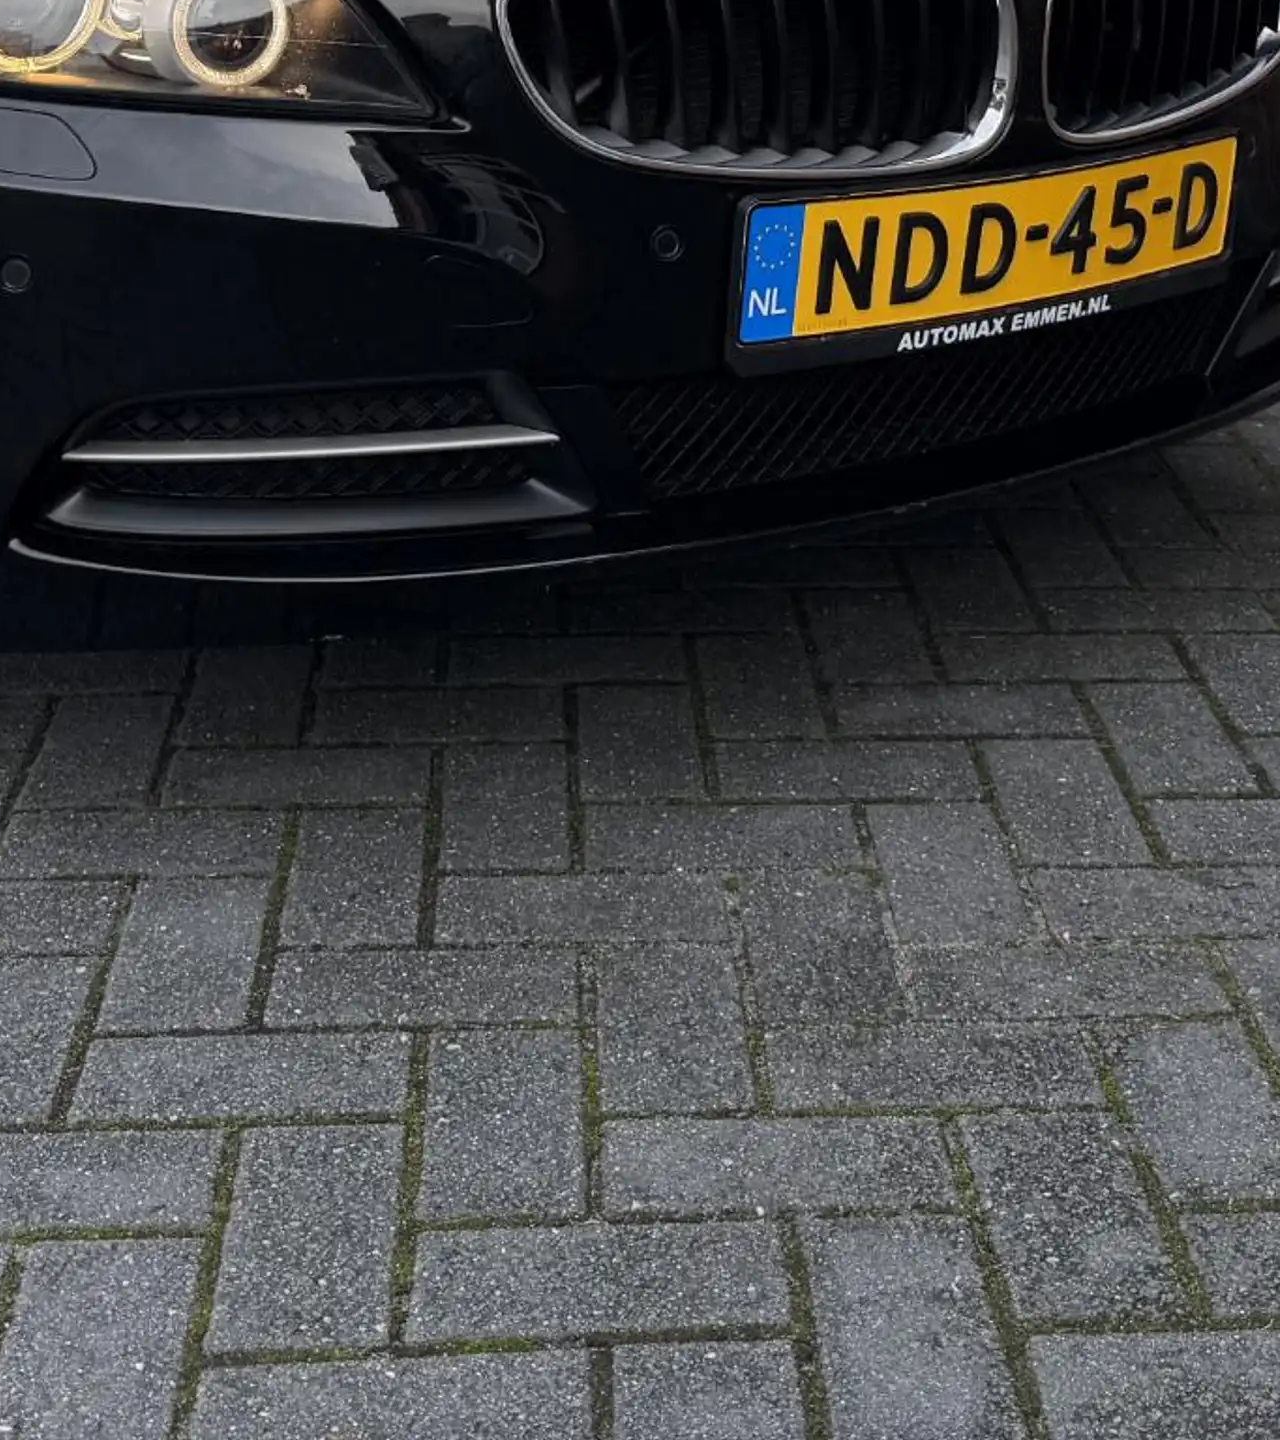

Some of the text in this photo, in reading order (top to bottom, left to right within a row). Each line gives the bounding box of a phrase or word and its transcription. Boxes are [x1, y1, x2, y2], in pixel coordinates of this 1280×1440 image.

[748, 161, 1219, 318] NL NDD-45-D
[897, 294, 1112, 353] AUTOMAX EMMEN.NL
